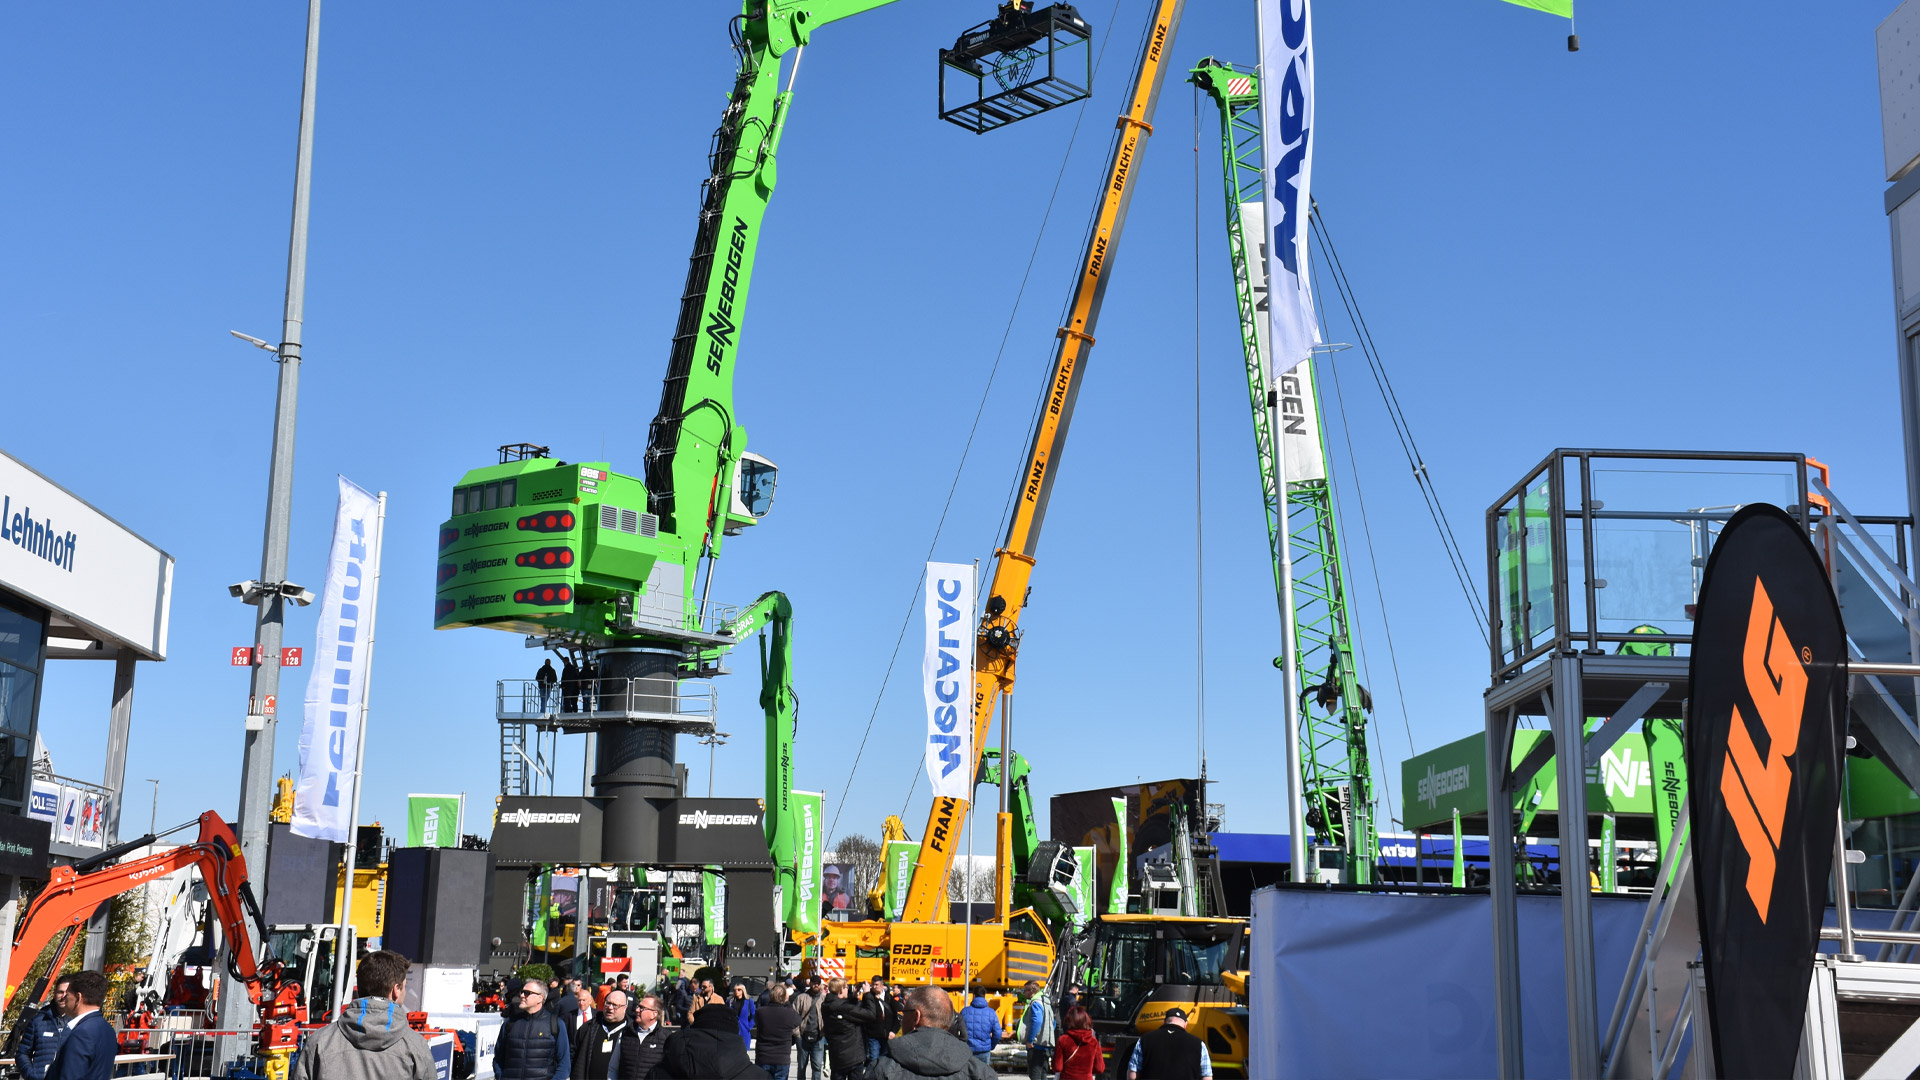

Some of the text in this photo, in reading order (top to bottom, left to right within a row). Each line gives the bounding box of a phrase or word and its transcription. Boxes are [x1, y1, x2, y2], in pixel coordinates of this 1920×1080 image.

[1150, 23, 1167, 63] FRANZ
[1089, 236, 1107, 277] FRANZ
[705, 215, 748, 377] SENNEBOGEN
[1026, 459, 1045, 502] FRANZ
[1, 495, 77, 573] Lehnhoff
[463, 521, 510, 538] SENNEBOGEN
[462, 557, 508, 574] SENNEBOGEN
[460, 593, 507, 610] SENNEBOGEN
[233, 656, 248, 665] 128
[285, 656, 299, 665] 128
[1720, 574, 1809, 925] JLG
[781, 742, 790, 812] SENNEBOGEN
[1417, 763, 1470, 810] SENNEBOGEN
[501, 808, 581, 828] SENNEBOGEN
[678, 809, 758, 829] SENNEBOGEN
[1378, 843, 1417, 858] ATSU
[129, 864, 165, 880] Kubota
[892, 944, 942, 956] 6203E
[892, 958, 926, 966] FRANZ
[892, 967, 919, 975] Erwitte
